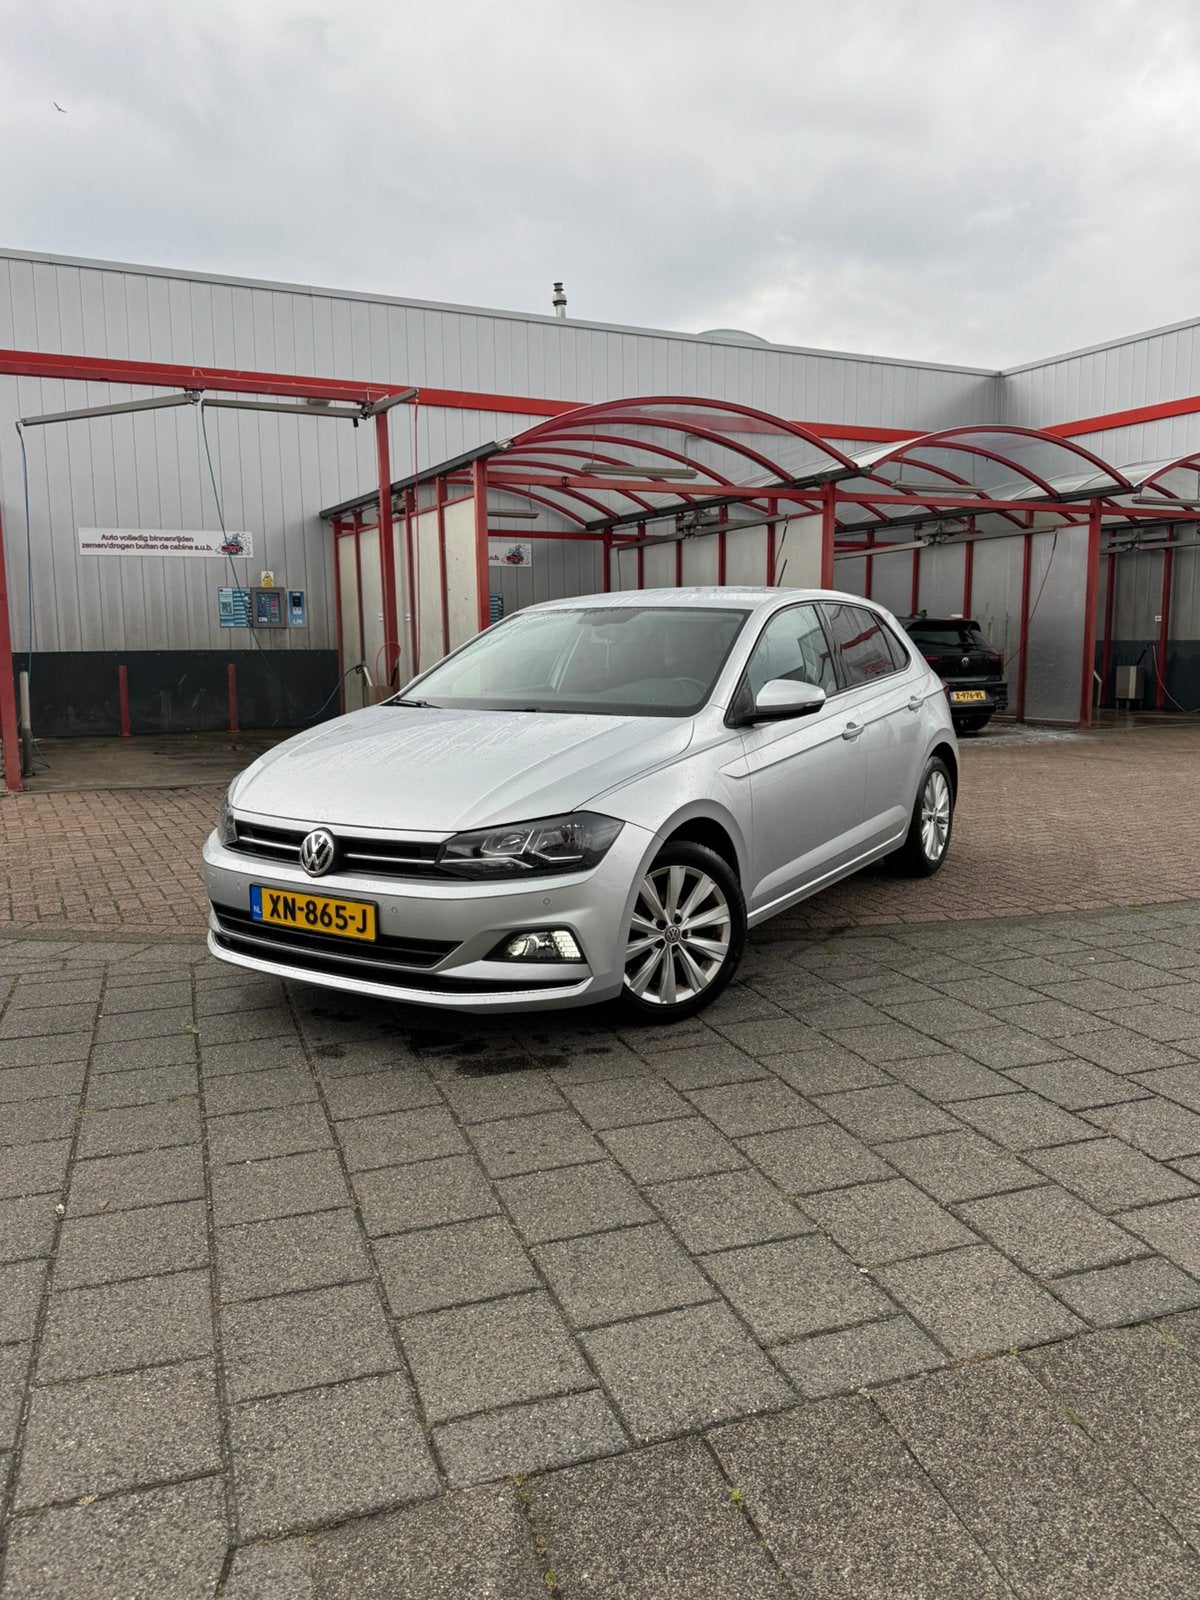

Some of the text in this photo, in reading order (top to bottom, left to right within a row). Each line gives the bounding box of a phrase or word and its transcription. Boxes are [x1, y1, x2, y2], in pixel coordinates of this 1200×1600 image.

[119, 534, 149, 542] volledig
[149, 535, 194, 543] binnenrijden
[81, 542, 135, 550] zemen/drogen
[253, 905, 262, 914] NL
[268, 893, 368, 934] XN-865-J
